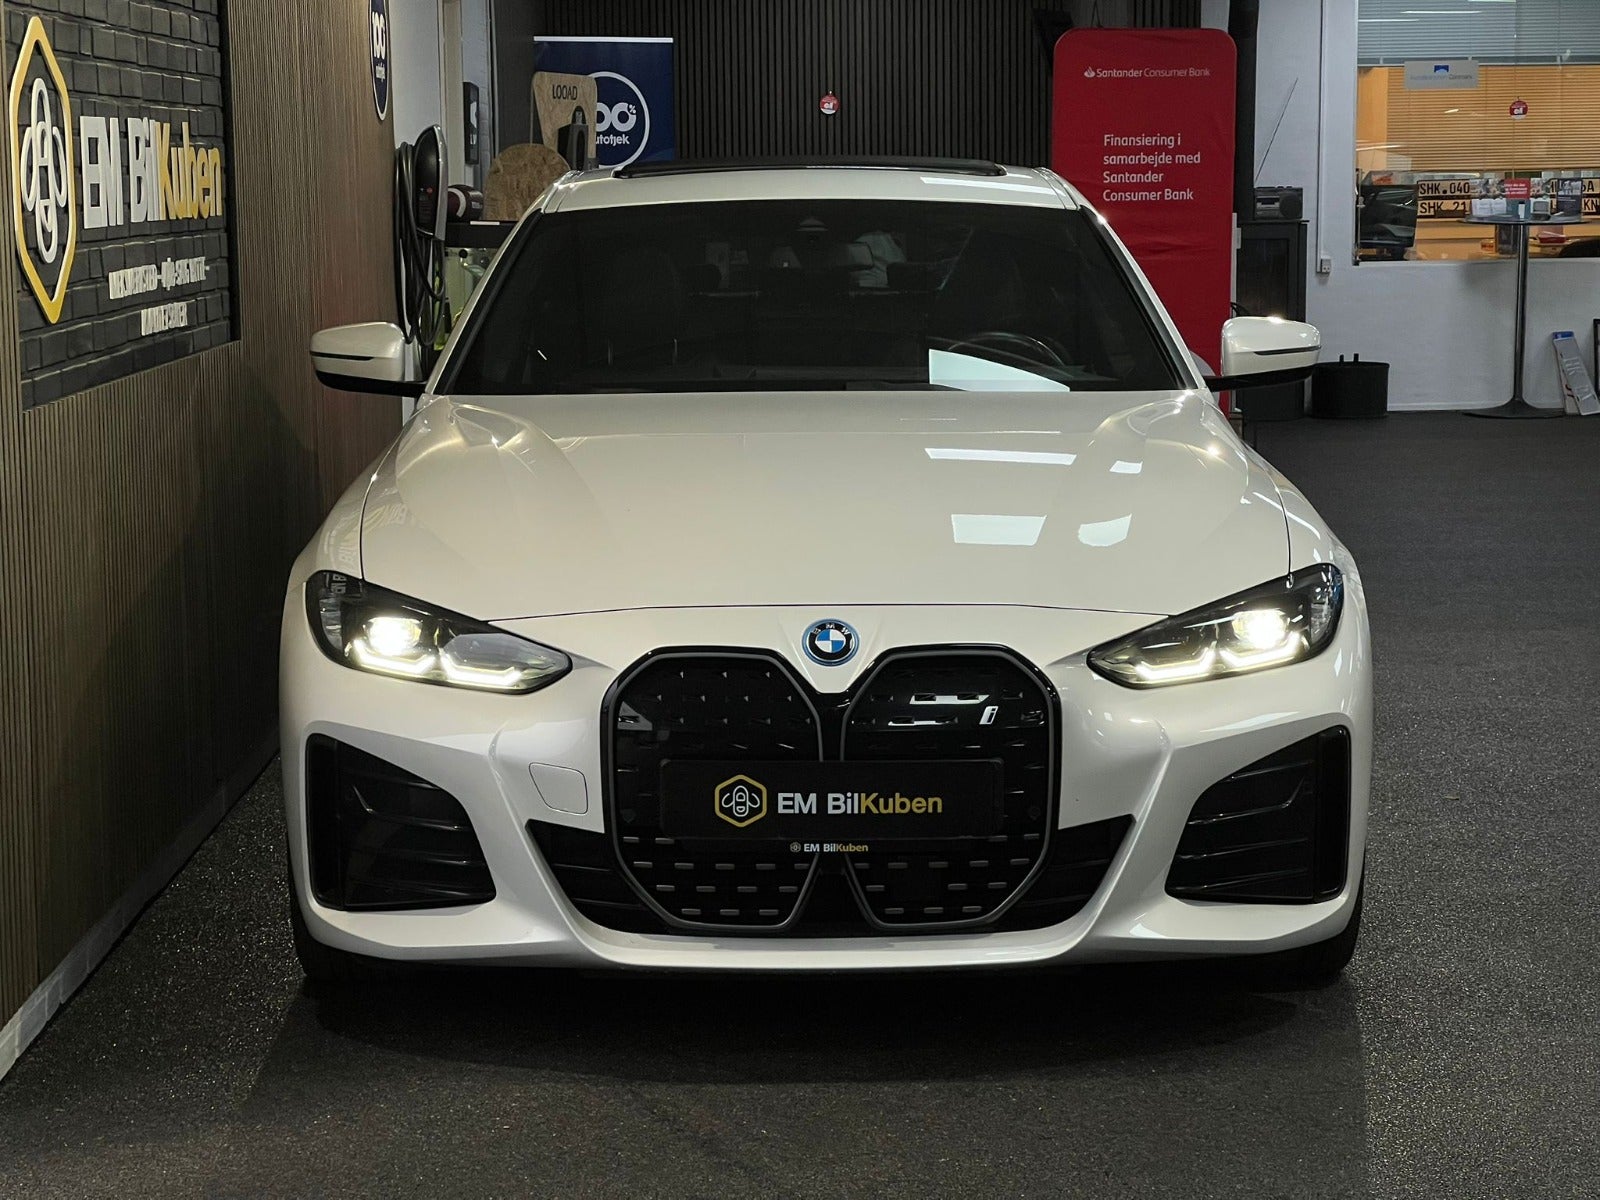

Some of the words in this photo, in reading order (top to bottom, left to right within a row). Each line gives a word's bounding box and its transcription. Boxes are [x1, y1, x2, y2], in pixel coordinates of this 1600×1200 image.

[1096, 68, 1143, 78] Santander
[1144, 68, 1187, 77] Consumer
[1189, 67, 1211, 77] Bank
[596, 102, 637, 132] 00%
[596, 134, 630, 146] utotjek
[1104, 134, 1175, 149] Finansiering
[1177, 133, 1181, 146] i
[1103, 153, 1172, 167] samarbejde
[1175, 152, 1201, 164] med
[80, 116, 124, 229] EM
[127, 117, 222, 223] BilKuben
[1103, 171, 1164, 183] Santander
[1103, 189, 1161, 201] Consumer
[1164, 189, 1194, 200] Bank
[813, 623, 851, 635] BMW
[777, 792, 817, 814] EM
[827, 792, 943, 814] BilKuben
[803, 843, 820, 852] EM
[823, 843, 869, 852] BilKuben
